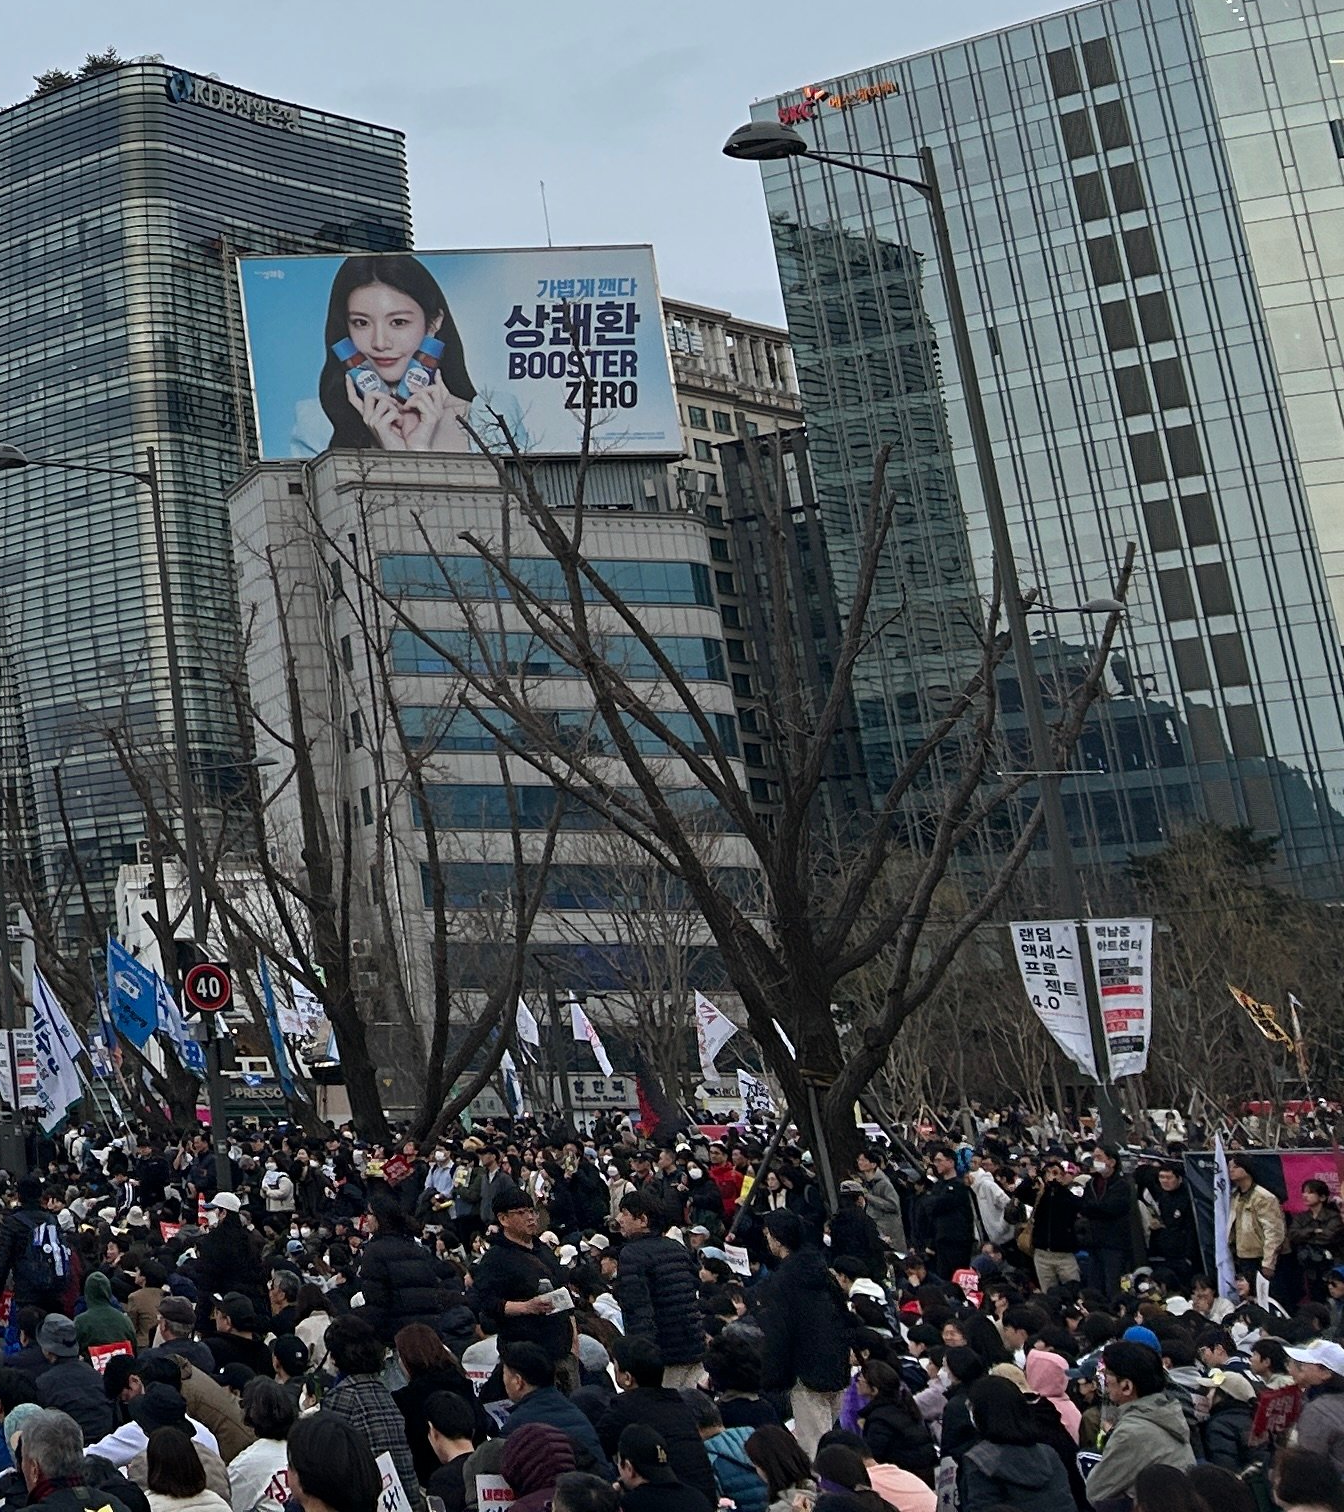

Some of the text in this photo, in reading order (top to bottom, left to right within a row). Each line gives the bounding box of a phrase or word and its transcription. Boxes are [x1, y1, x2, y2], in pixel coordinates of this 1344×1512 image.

[536, 278, 637, 298] 가볍게 깬다
[504, 301, 640, 348] 상쾌환
[509, 350, 638, 379] BOOSTER
[564, 380, 638, 409] ZERO
[1019, 927, 1052, 943] 랜덤
[1095, 926, 1131, 938] 백남준
[1021, 944, 1073, 959] 액세스
[1097, 939, 1142, 951] 아트센터
[1025, 961, 1059, 976] 프로
[196, 976, 221, 998] 40
[1045, 979, 1079, 996] 젝트
[1032, 994, 1061, 1010] 4.0
